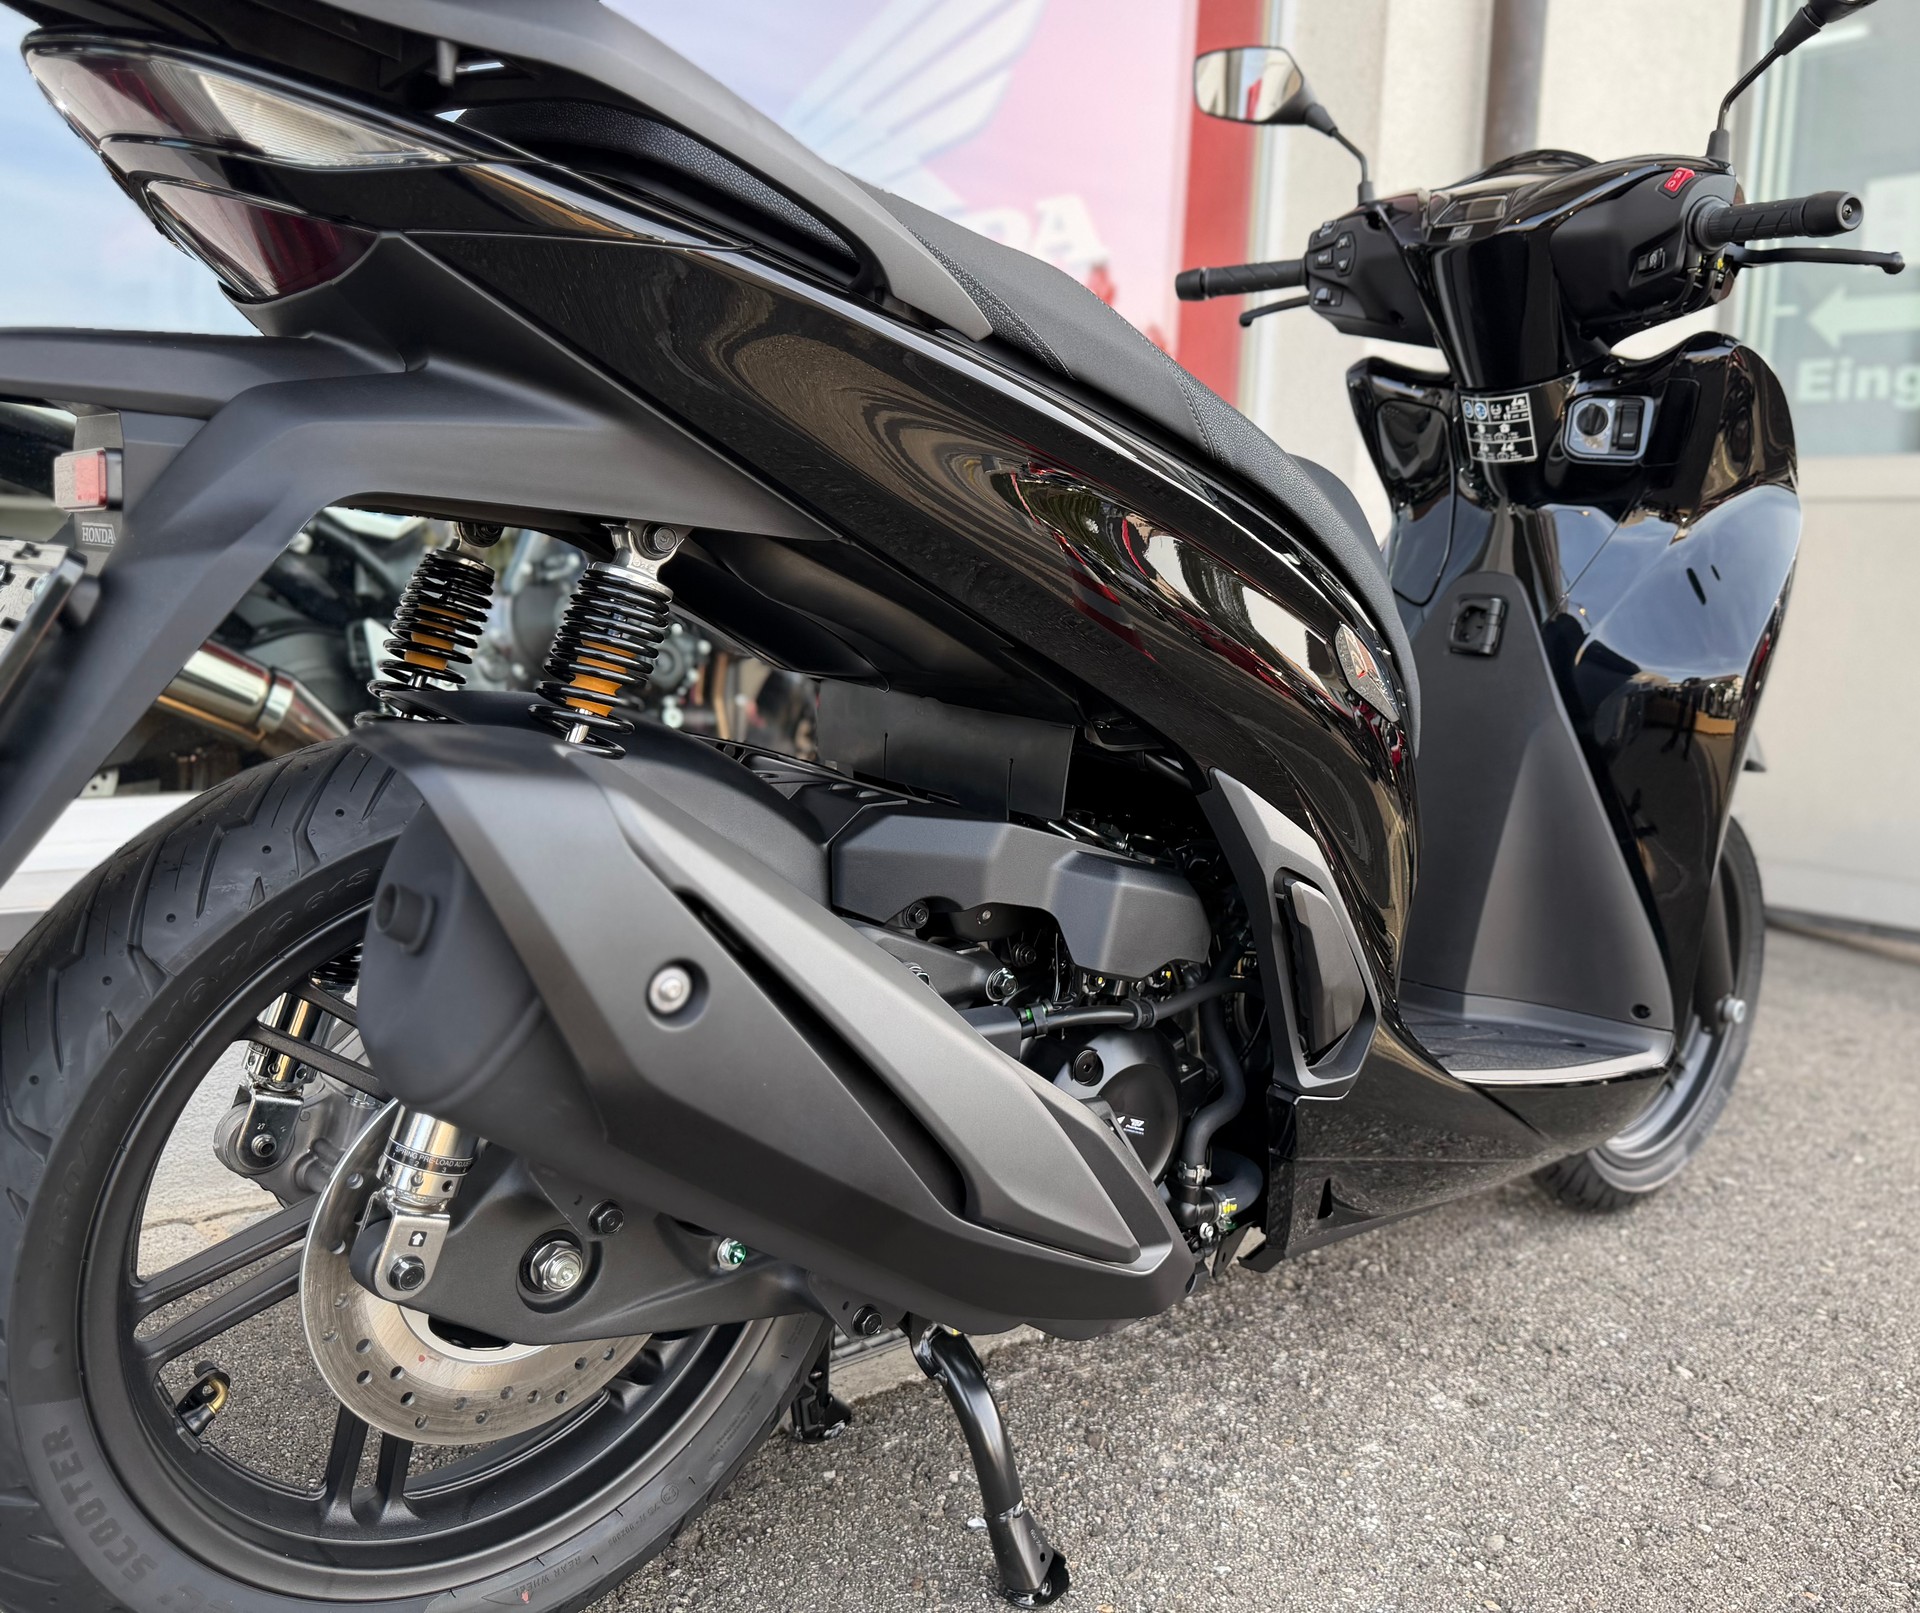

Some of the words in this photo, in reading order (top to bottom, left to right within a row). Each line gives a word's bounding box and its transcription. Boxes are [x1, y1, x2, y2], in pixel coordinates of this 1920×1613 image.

[1797, 358, 1920, 410] Eing
[82, 526, 115, 544] HONDA
[395, 1145, 418, 1160] SPRING
[419, 1154, 454, 1167] PRE-LOAD
[41, 1424, 158, 1583] SCOOTER
[553, 1555, 582, 1576] REAR
[512, 1573, 550, 1597] WHEEL
